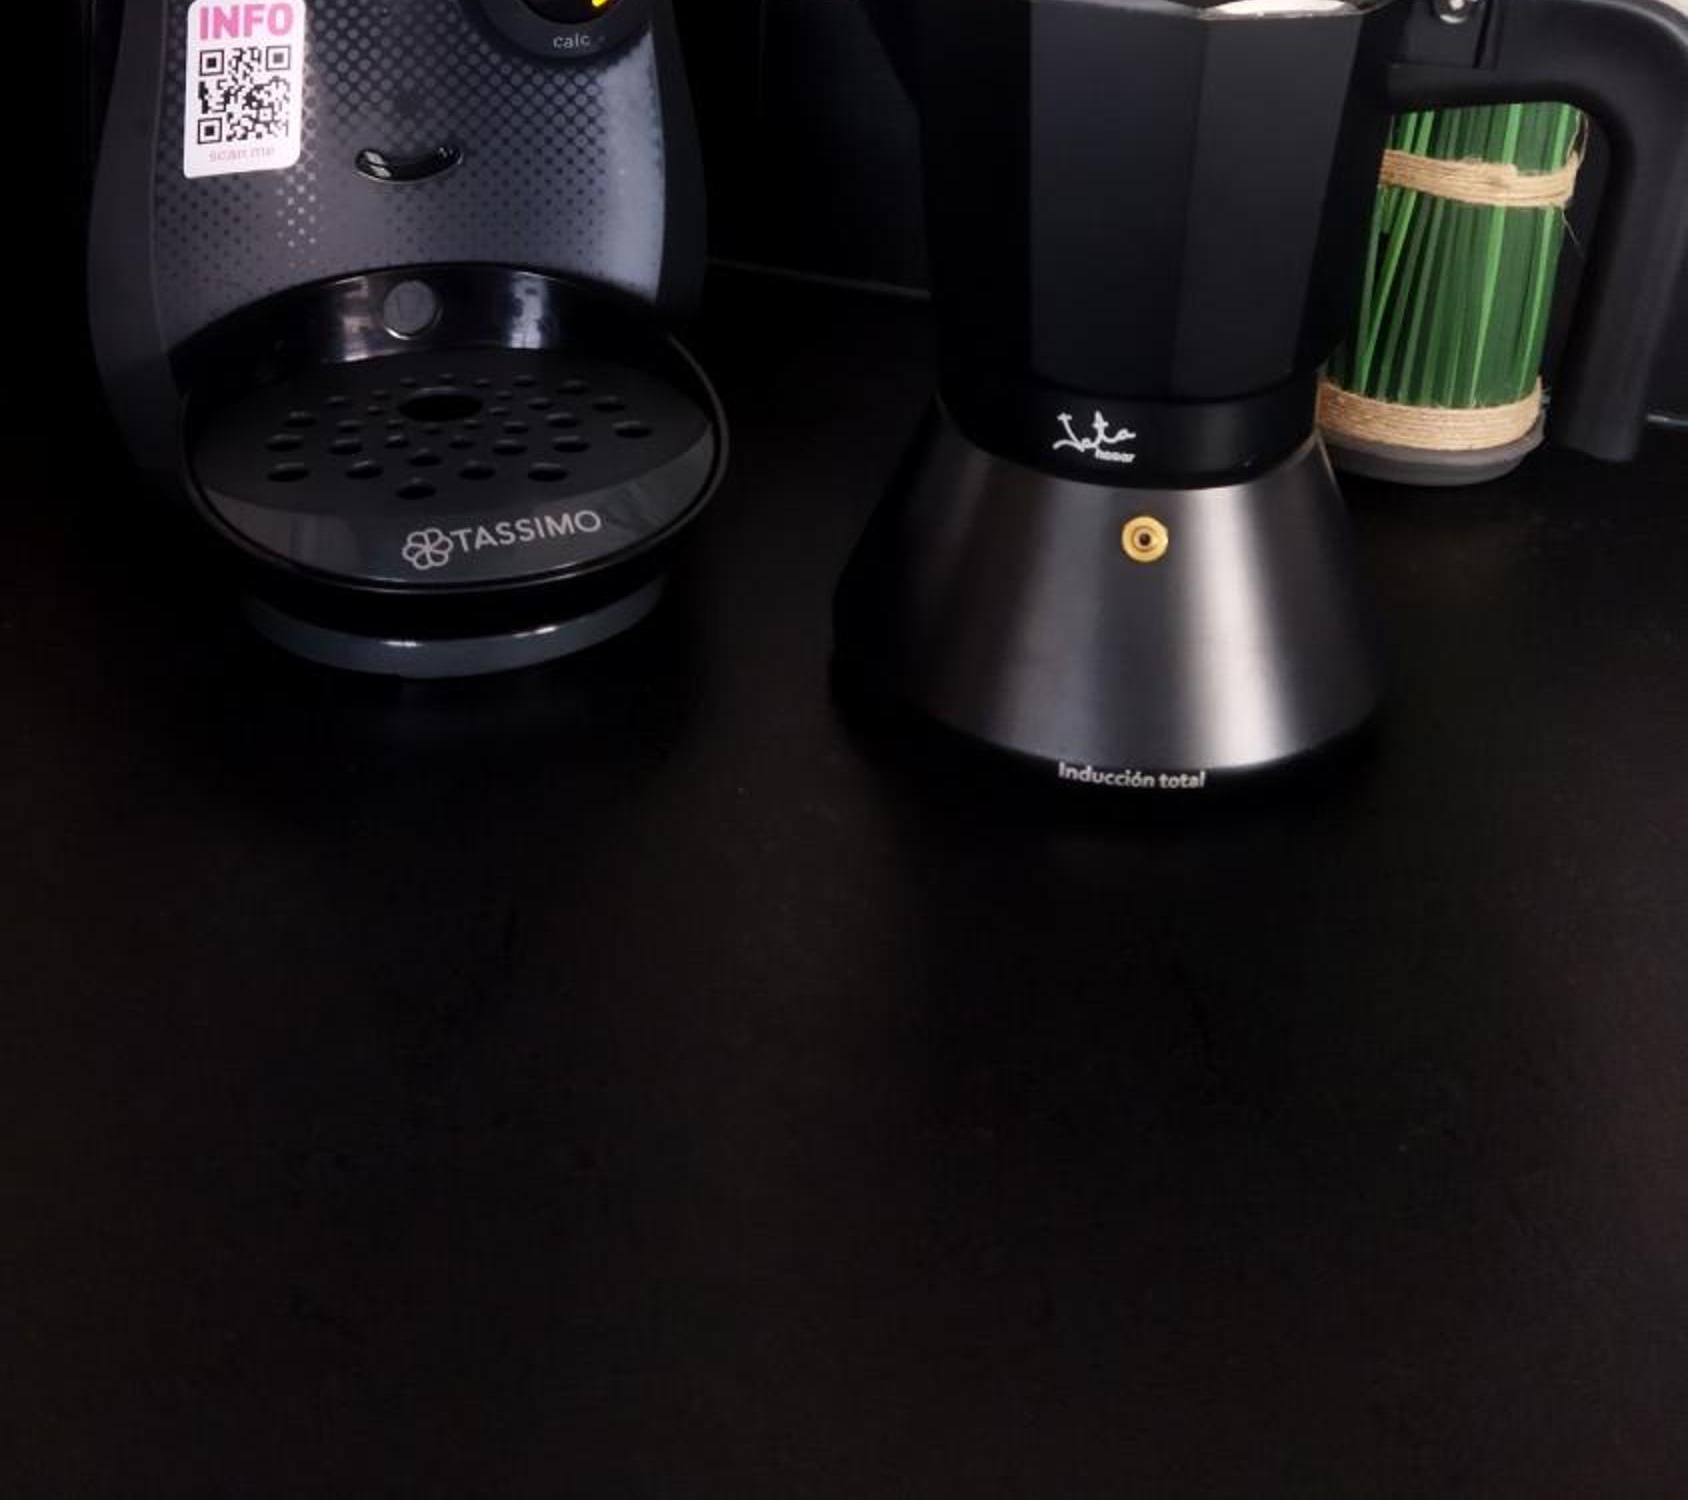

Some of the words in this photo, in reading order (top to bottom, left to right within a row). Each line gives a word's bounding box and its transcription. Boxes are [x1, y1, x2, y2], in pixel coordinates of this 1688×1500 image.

[199, 2, 293, 40] INFO
[553, 33, 591, 49] calc
[450, 510, 601, 552] TASSIMO
[1058, 762, 1155, 787] Inducción
[1159, 771, 1206, 788] total
